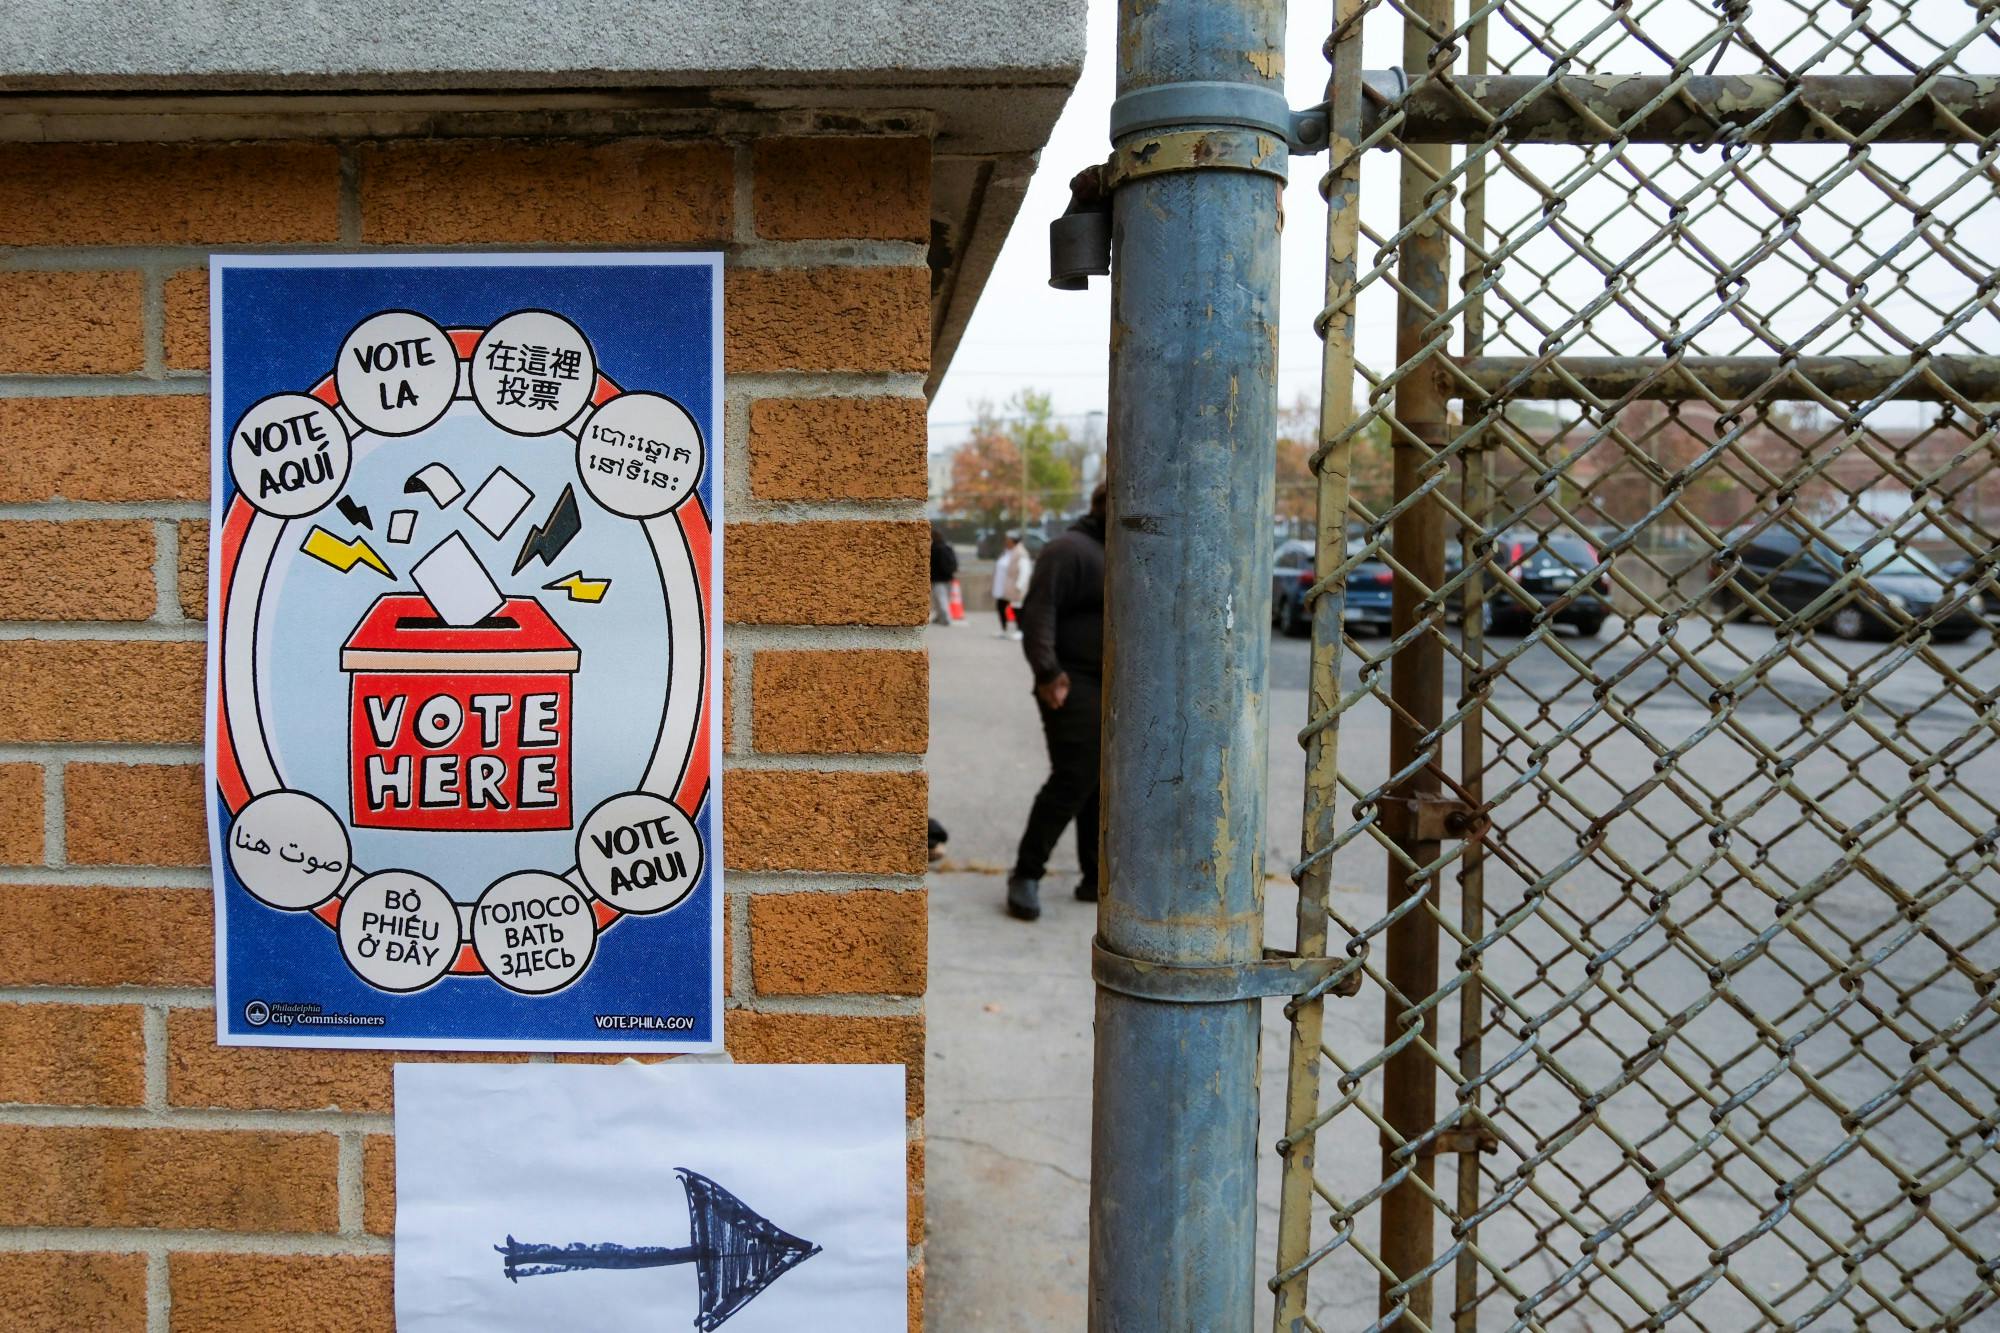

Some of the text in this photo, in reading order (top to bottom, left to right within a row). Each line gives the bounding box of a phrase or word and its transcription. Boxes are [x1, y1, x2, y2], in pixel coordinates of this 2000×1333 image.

[353, 337, 436, 374] VOTE
[486, 340, 582, 381] 在這裡
[379, 379, 419, 410] LA
[496, 374, 562, 412] 投票
[240, 410, 327, 457] VOTE
[259, 440, 335, 499] AQUÍ
[363, 692, 561, 750] VOTE
[364, 754, 560, 812] HERE
[235, 825, 343, 874] صوت هنا
[590, 815, 680, 859] VOTE
[610, 851, 688, 896] AQUI
[385, 888, 422, 912] BỎ
[480, 894, 580, 926] ГОЛОСО
[357, 932, 440, 967] Ở ĐÂY
[505, 922, 565, 949] ВАТЬ
[500, 947, 576, 978] ЗДЕСЬ
[271, 1004, 321, 1013] Philadelphia
[271, 1013, 385, 1025] City Commissioners
[595, 1015, 694, 1030] VOTE.PHILA.GOV
